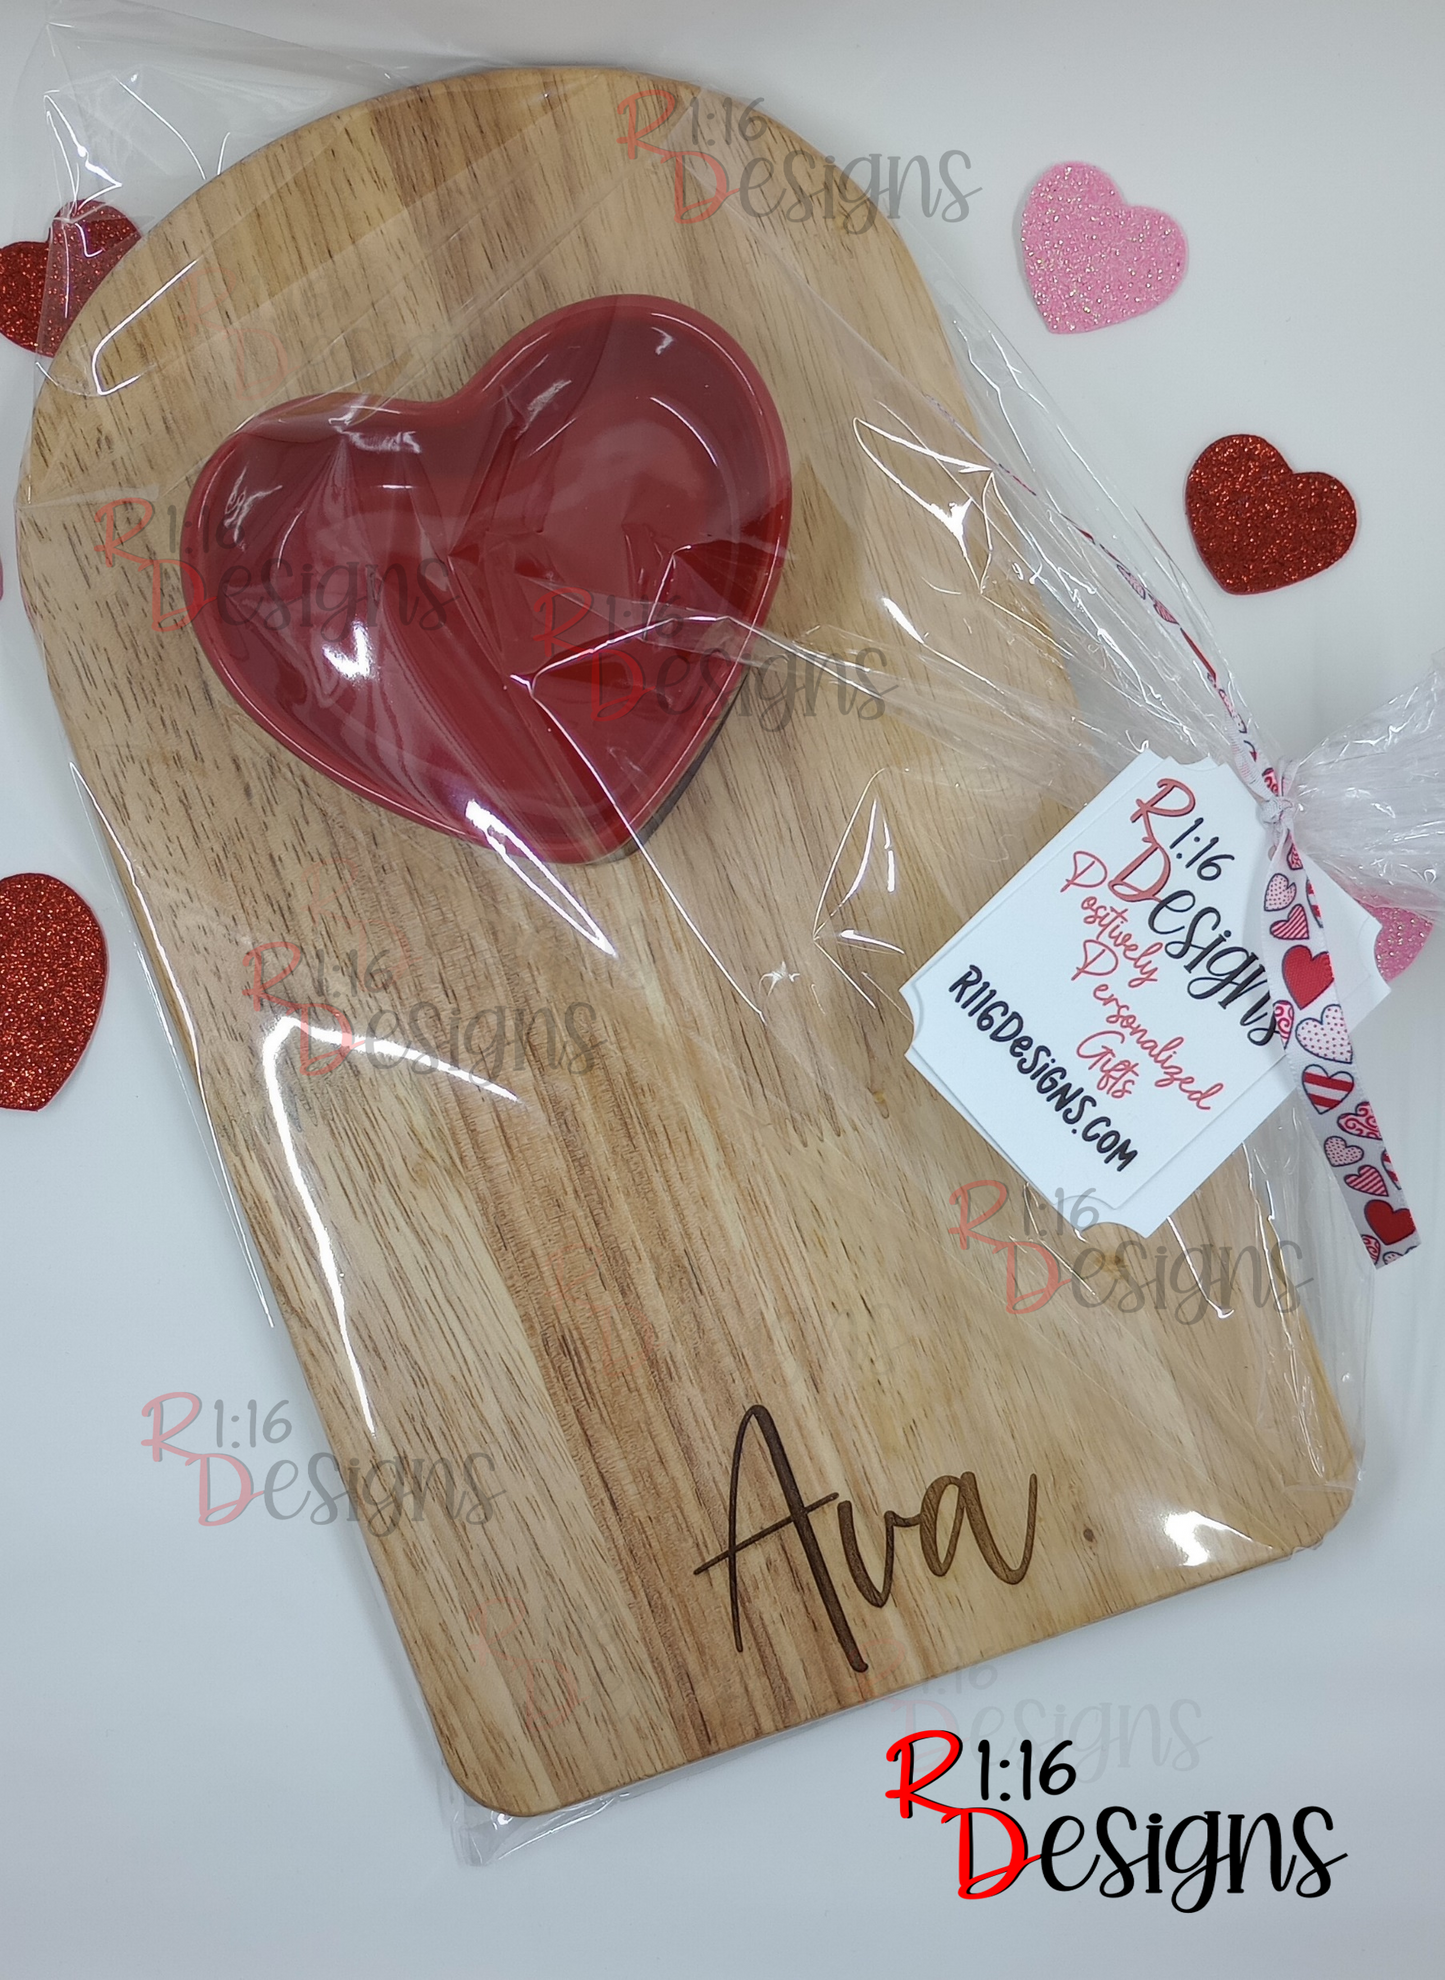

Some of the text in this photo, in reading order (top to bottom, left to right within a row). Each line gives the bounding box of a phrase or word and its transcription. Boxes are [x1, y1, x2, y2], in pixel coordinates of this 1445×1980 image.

[1060, 851, 1163, 988] Positively
[1071, 940, 1224, 1110] Personalized
[1076, 1030, 1139, 1099] Gifts
[693, 1404, 1038, 1673] Ava
